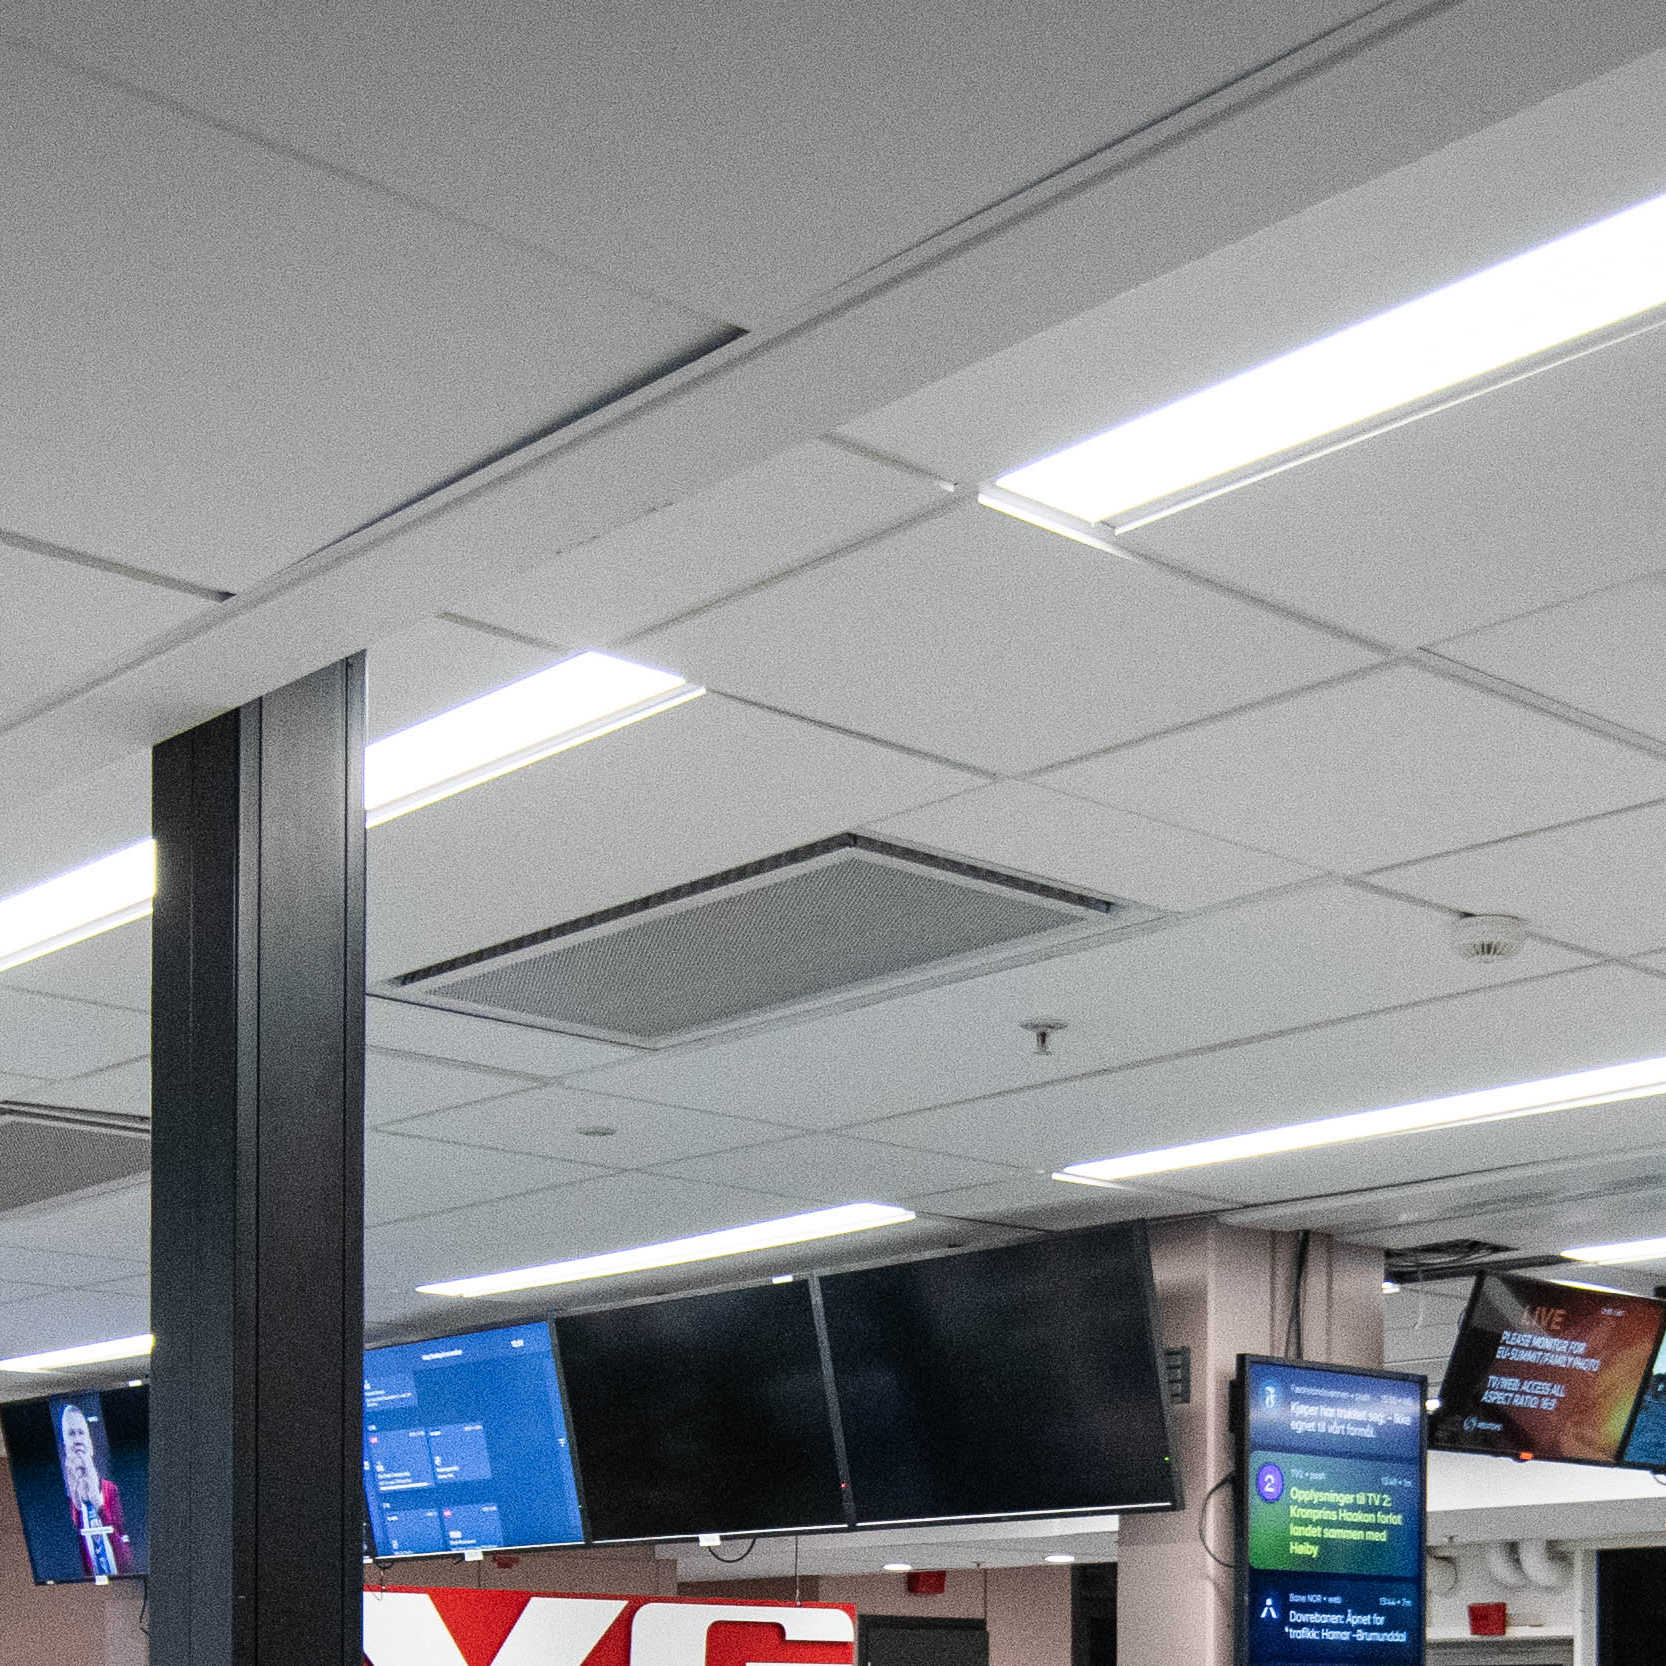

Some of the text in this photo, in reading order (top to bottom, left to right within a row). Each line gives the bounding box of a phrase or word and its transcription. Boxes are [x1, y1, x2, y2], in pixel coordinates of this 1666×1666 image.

[1500, 1330, 1587, 1354] PLEASE MONITOR FOR
[1264, 1475, 1275, 1492] 2
[1367, 1493, 1381, 1505] TV
[1339, 1509, 1376, 1522] Haakon
[1290, 1524, 1387, 1541] landet sammen med
[1321, 1628, 1351, 1640] Hamar
